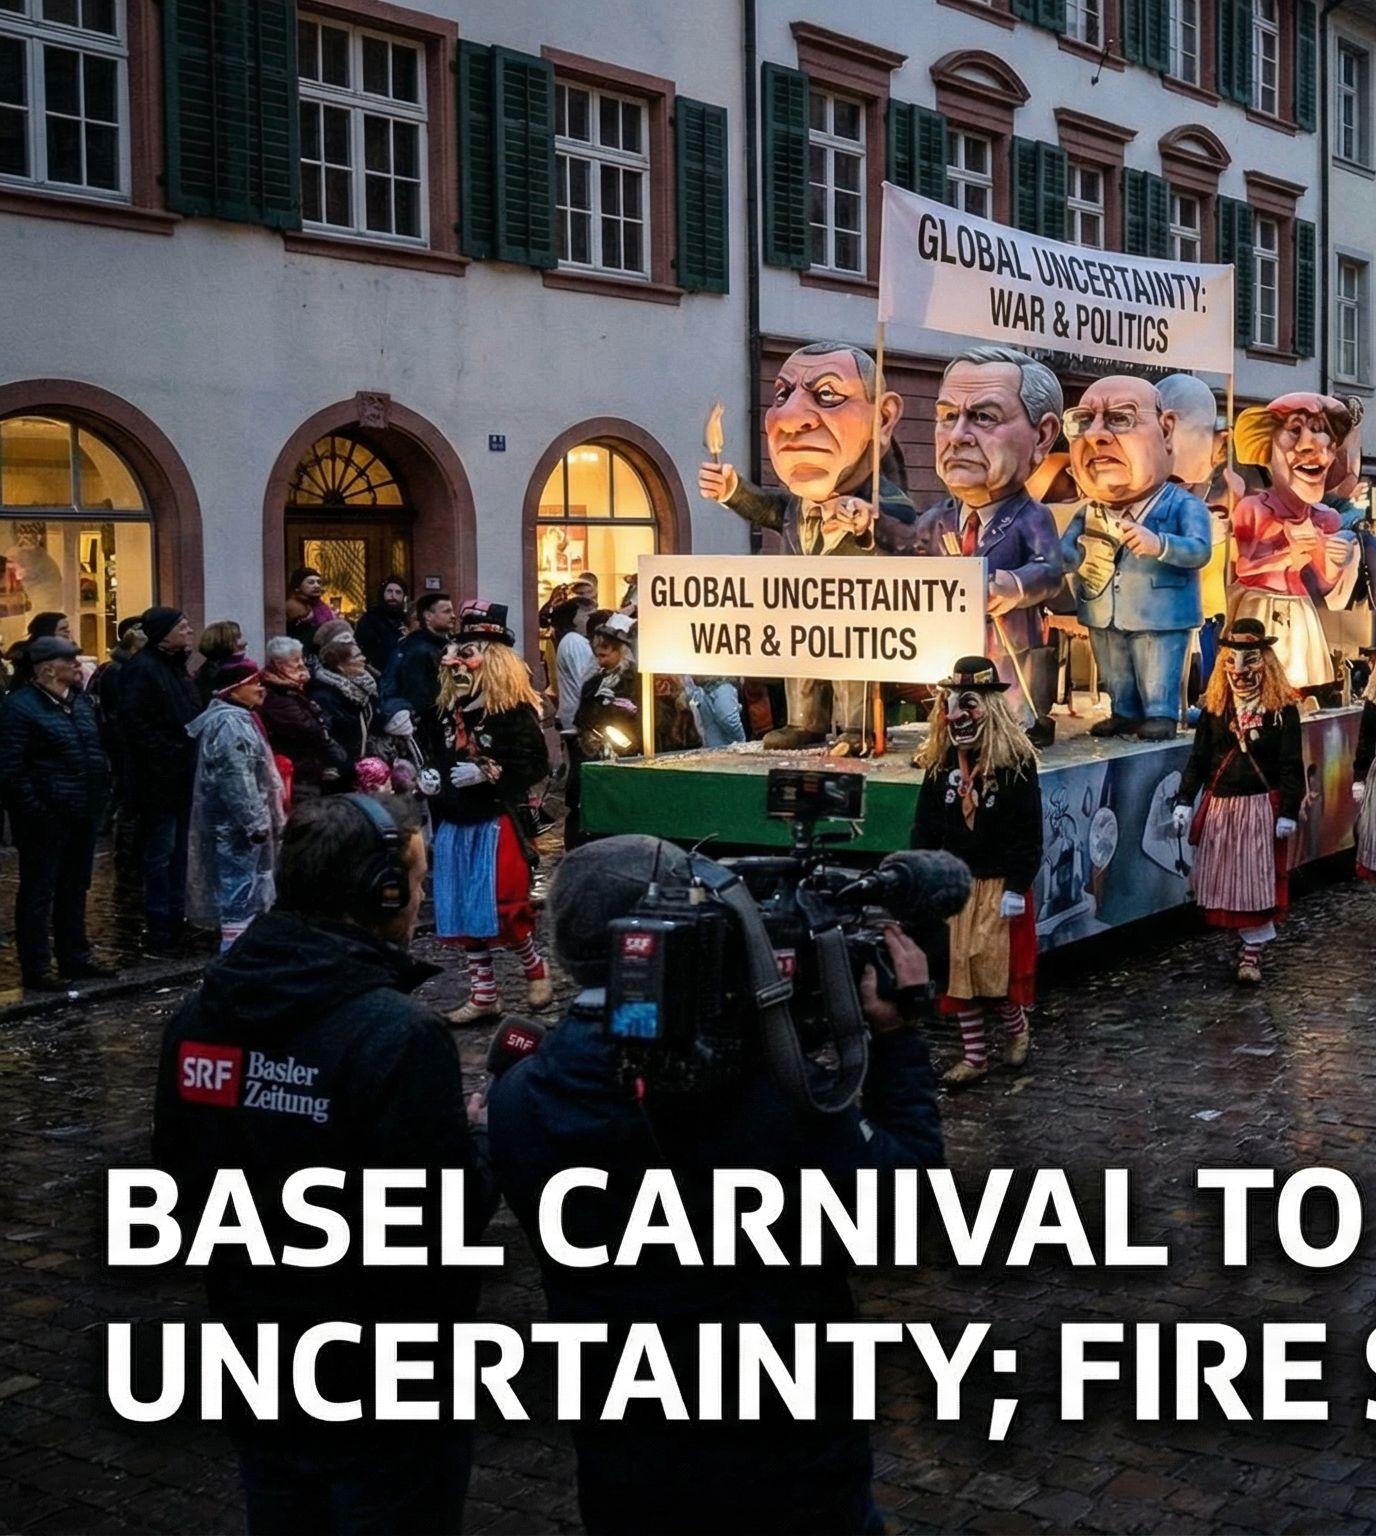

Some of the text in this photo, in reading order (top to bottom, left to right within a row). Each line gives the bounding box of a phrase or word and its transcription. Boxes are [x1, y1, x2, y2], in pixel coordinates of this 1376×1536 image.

[917, 213, 1207, 314] GLOBAL UNCERTAINTY:
[990, 286, 1169, 353] WAR & POLITICS
[650, 575, 967, 613] GLOBAL UNCERTAINTY:
[690, 622, 918, 661] WAR & POLITICS
[183, 1056, 233, 1091] SRF
[246, 1050, 319, 1086] Basler
[243, 1081, 331, 1123] Zeitung
